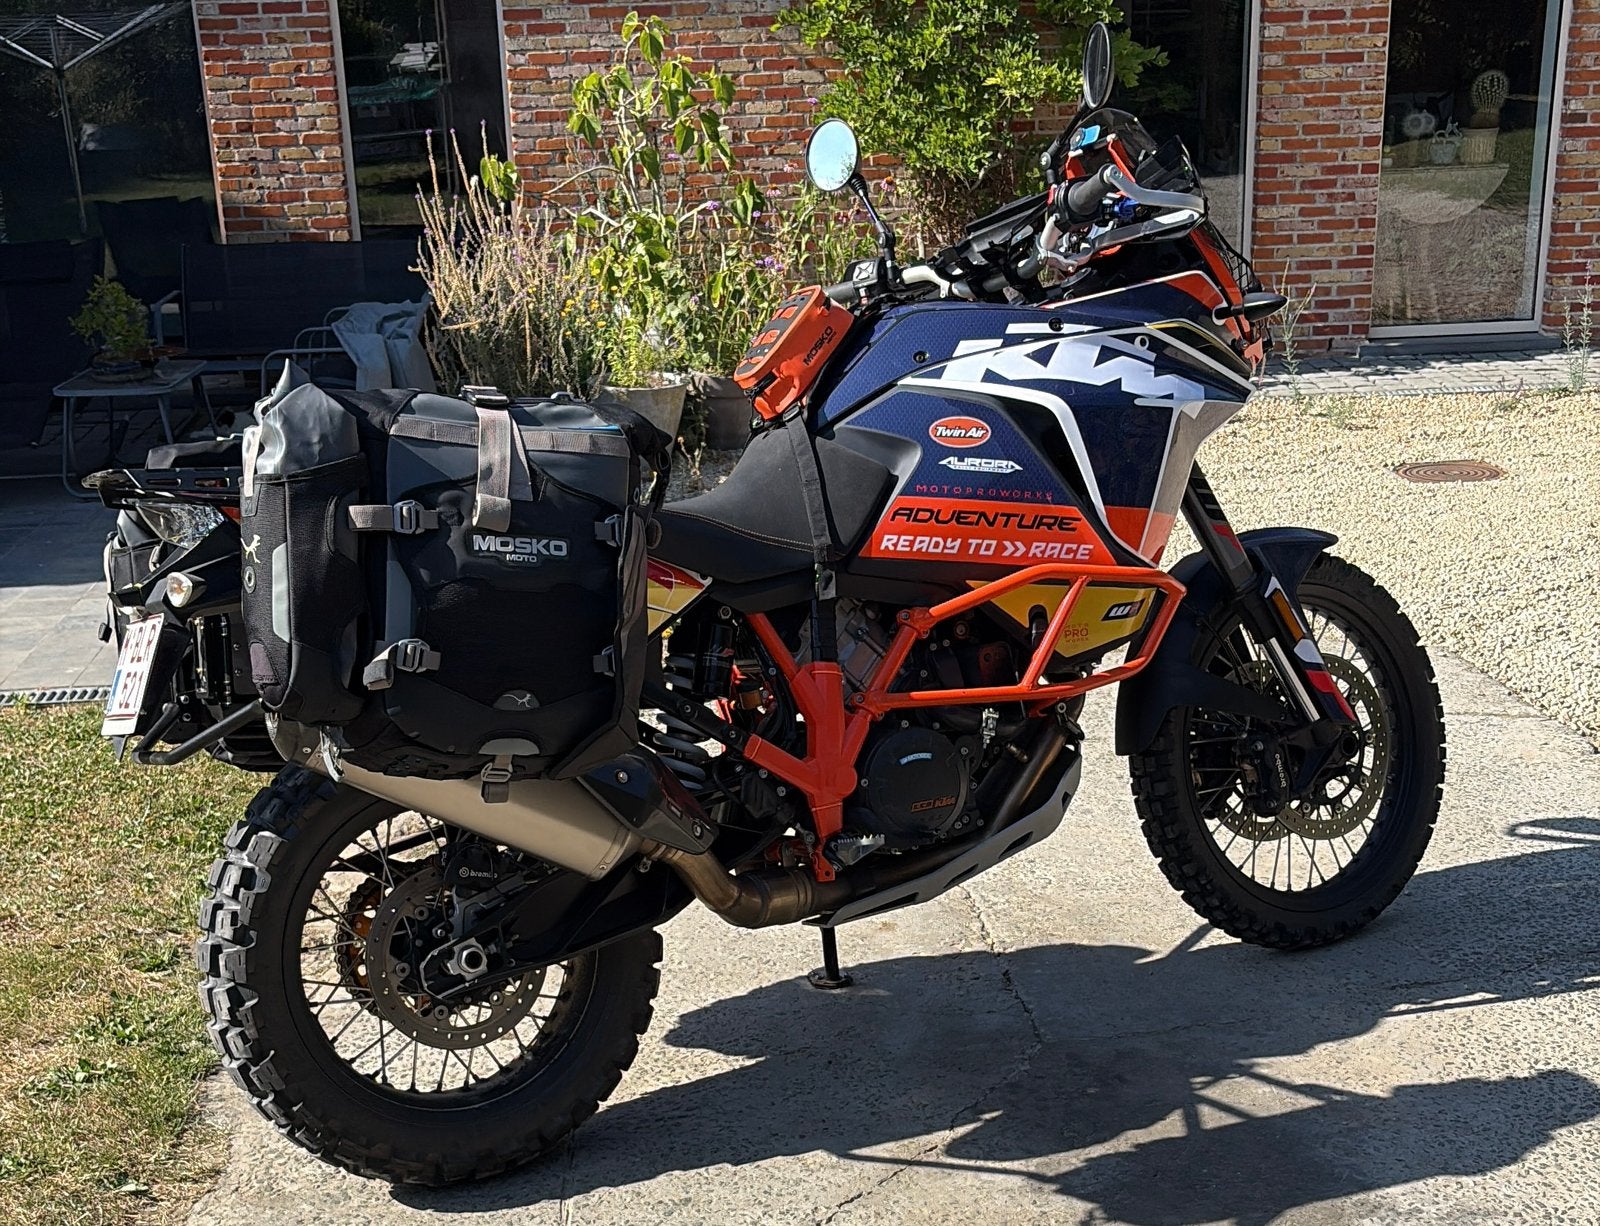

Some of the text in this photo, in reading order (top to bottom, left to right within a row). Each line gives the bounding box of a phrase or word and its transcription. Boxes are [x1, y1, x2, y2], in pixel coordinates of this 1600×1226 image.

[803, 326, 833, 366] MOSKO
[936, 426, 987, 438] Twin Air
[938, 456, 1024, 471] AURORA
[916, 485, 1053, 500] MOTOPROWORKS
[890, 507, 1082, 532] ADVENTURE
[473, 535, 568, 556] MOSKO
[880, 535, 1094, 560] READY TO RACE
[506, 554, 537, 562] MOTO
[1065, 628, 1089, 639] PRO
[119, 671, 143, 708] 521
[1274, 753, 1287, 788] brembo
